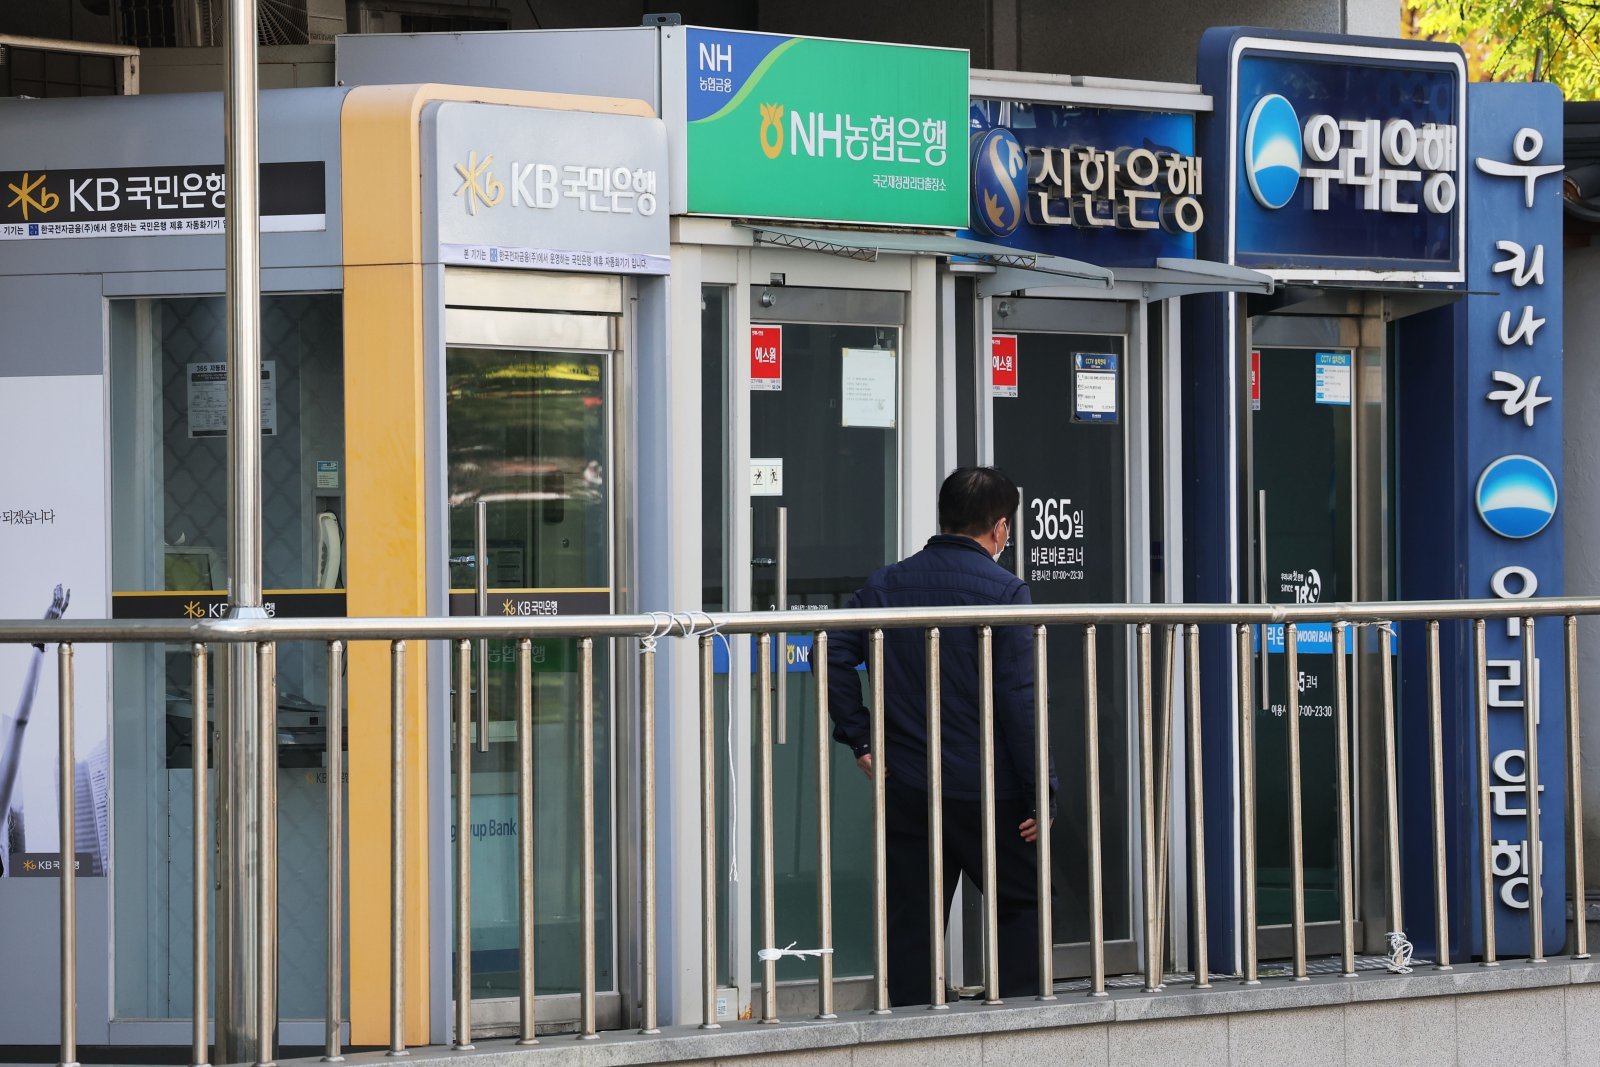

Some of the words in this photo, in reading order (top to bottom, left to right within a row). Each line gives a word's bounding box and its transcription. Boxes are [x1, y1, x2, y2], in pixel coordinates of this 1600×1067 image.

[699, 42, 732, 73] NH
[699, 76, 732, 93] 농협금융
[790, 110, 947, 166] NH농협은행
[1299, 114, 1457, 214] 우리은행
[1034, 146, 1204, 233] 신한은행
[3, 225, 24, 235] 기기는
[110, 221, 137, 233] 운영하는
[139, 221, 167, 231] 국민은행
[169, 220, 183, 230] 제휴
[186, 219, 220, 230] 자동화기기
[471, 249, 486, 261] 기기는
[550, 252, 569, 265] 운영하는
[571, 254, 591, 267] 국민은행
[754, 347, 776, 364] 에스원
[992, 355, 1013, 371] 에스원
[2, 509, 56, 525] 되겠습니다
[1030, 497, 1084, 540] 365일
[1031, 545, 1084, 567] 바로바로코너
[1031, 569, 1051, 581] 운영시간
[1305, 675, 1318, 689] 코너
[1298, 705, 1333, 717] 7:00~23:30
[489, 818, 517, 837] Bank
